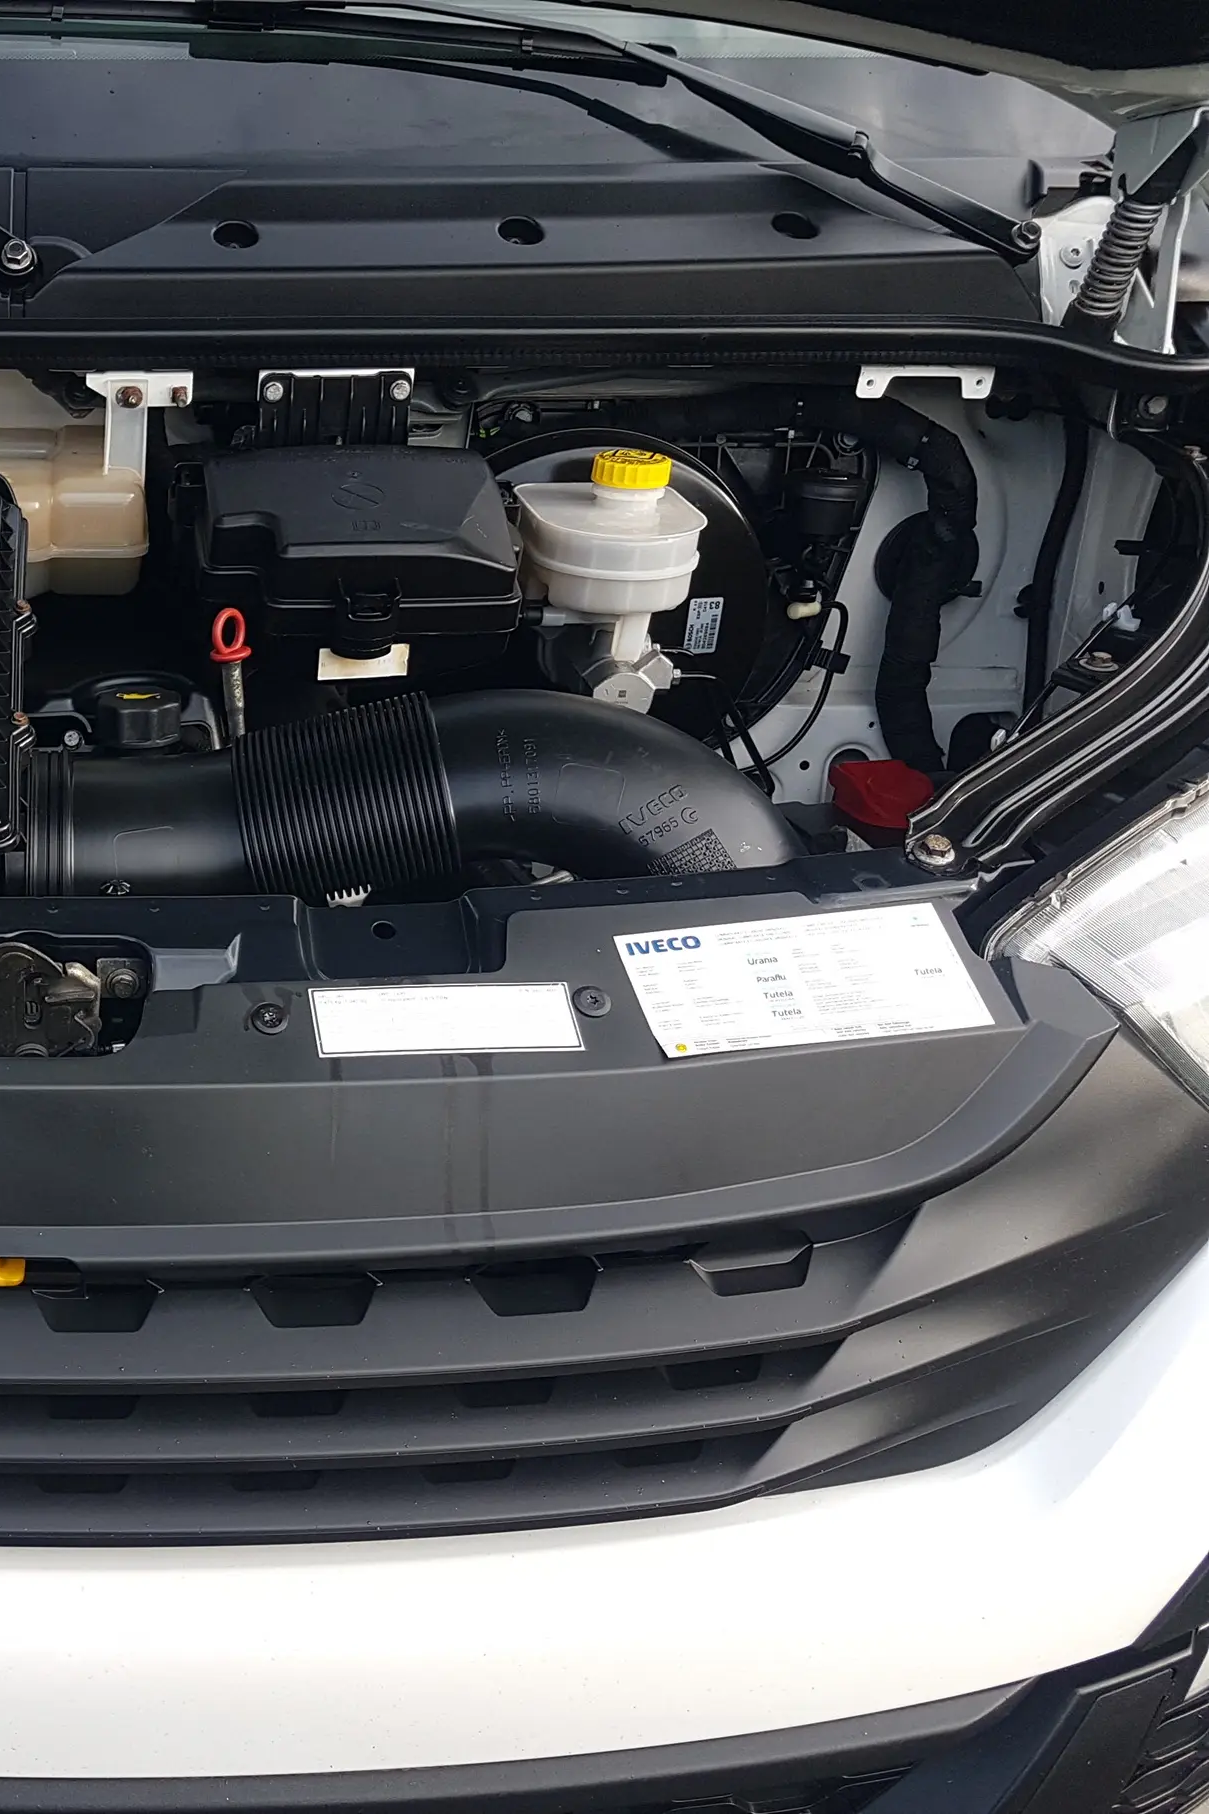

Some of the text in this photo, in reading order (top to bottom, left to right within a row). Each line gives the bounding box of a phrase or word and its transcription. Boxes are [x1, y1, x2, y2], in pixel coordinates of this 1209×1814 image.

[618, 784, 688, 835] IVECO
[638, 816, 679, 847] 57965
[625, 936, 701, 956] IVECO
[747, 956, 779, 966] Urania
[914, 967, 943, 976] Tutela
[756, 973, 787, 983] Paraflu
[763, 989, 794, 1000] Tutela
[771, 1007, 802, 1018] Tutela
